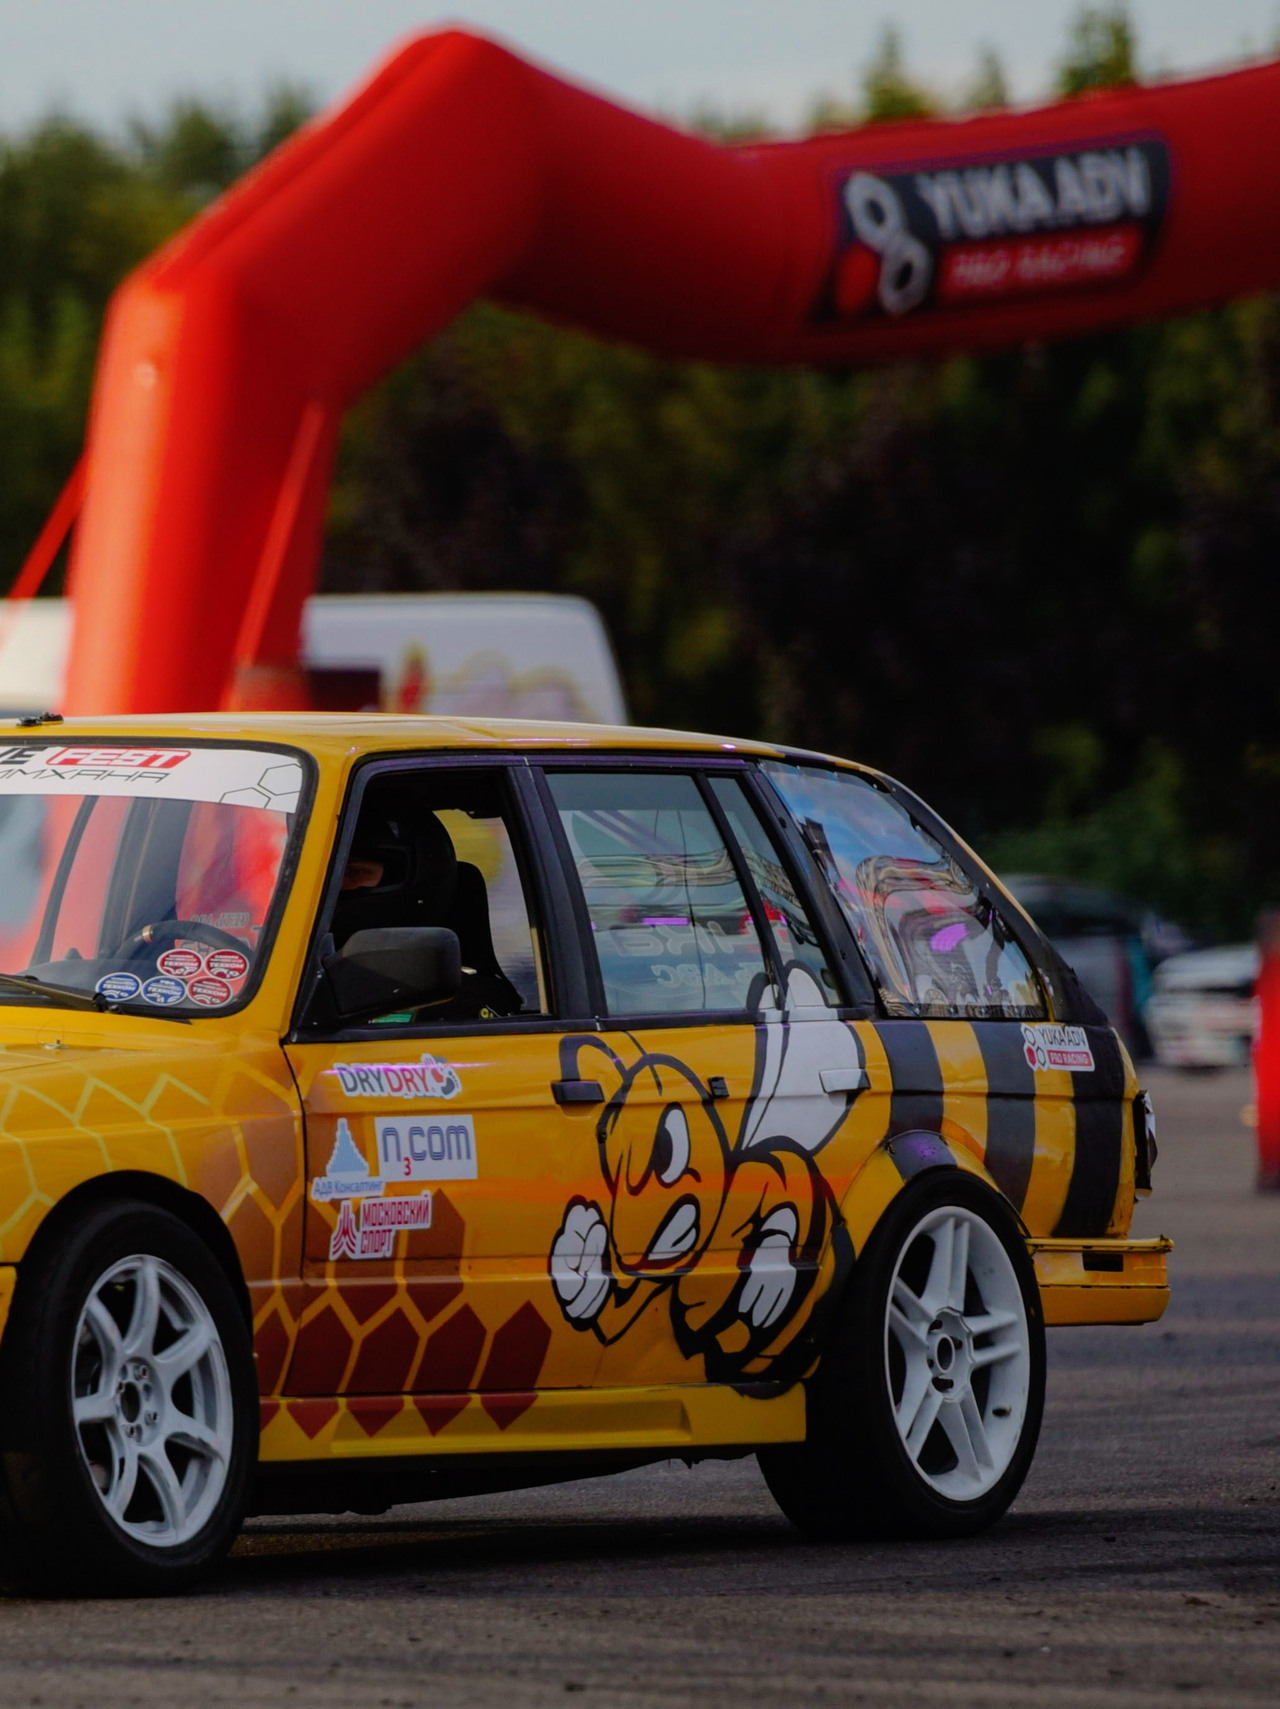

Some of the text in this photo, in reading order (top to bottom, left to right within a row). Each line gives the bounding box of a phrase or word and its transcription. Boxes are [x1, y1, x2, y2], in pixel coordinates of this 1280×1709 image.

[48, 749, 188, 768] FEST
[1037, 1028, 1087, 1047] YUKA ADV
[1049, 1052, 1089, 1065] PRO RACING
[335, 1065, 429, 1093] DRYDRY
